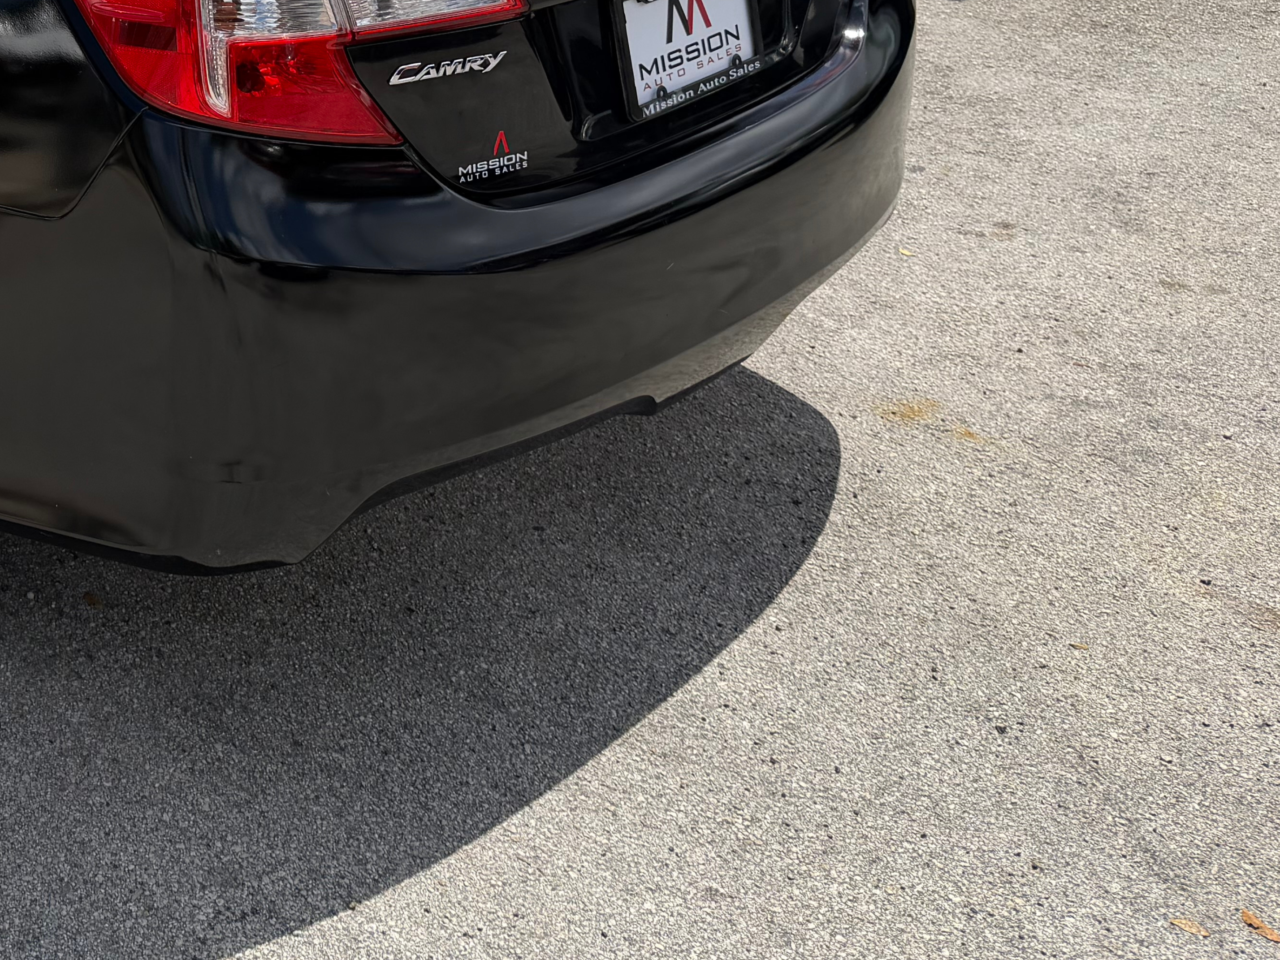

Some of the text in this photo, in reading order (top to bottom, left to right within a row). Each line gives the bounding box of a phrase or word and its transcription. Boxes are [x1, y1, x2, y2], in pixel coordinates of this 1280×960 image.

[638, 24, 740, 81] MISSION
[643, 43, 742, 92] AUTO SALES
[642, 60, 761, 118] Mission Auto Sales
[458, 151, 528, 176] MISSION
[459, 161, 528, 183] AUTO SALES
